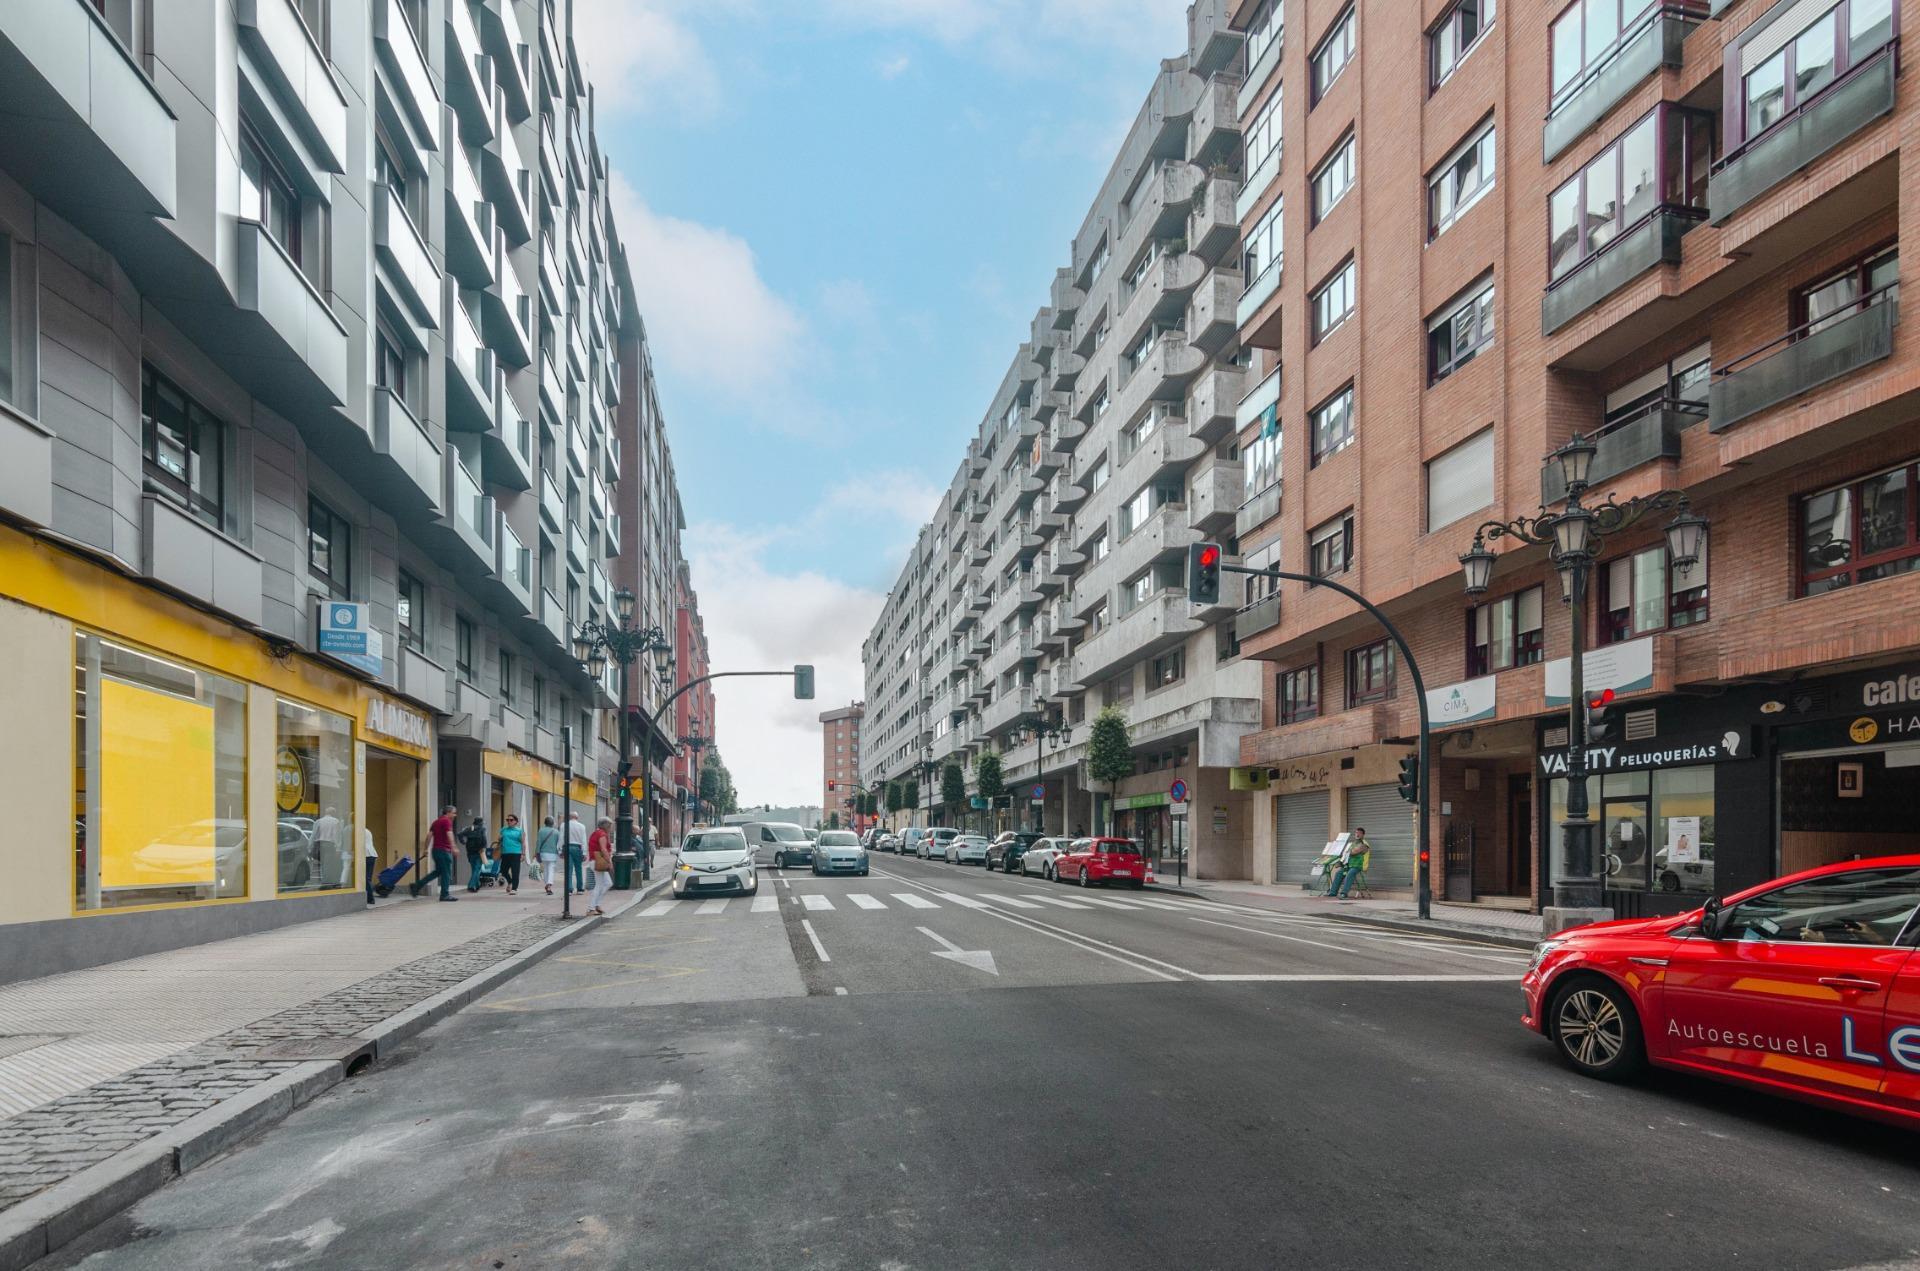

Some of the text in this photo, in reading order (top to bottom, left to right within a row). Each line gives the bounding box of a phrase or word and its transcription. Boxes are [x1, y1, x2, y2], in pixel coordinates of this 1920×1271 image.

[1443, 698, 1467, 712] CIMA
[366, 699, 431, 748] ALIMERKA
[1540, 745, 1716, 774] VAITY PELUQUERÍAS
[1667, 1018, 1828, 1058] Autoescuela
